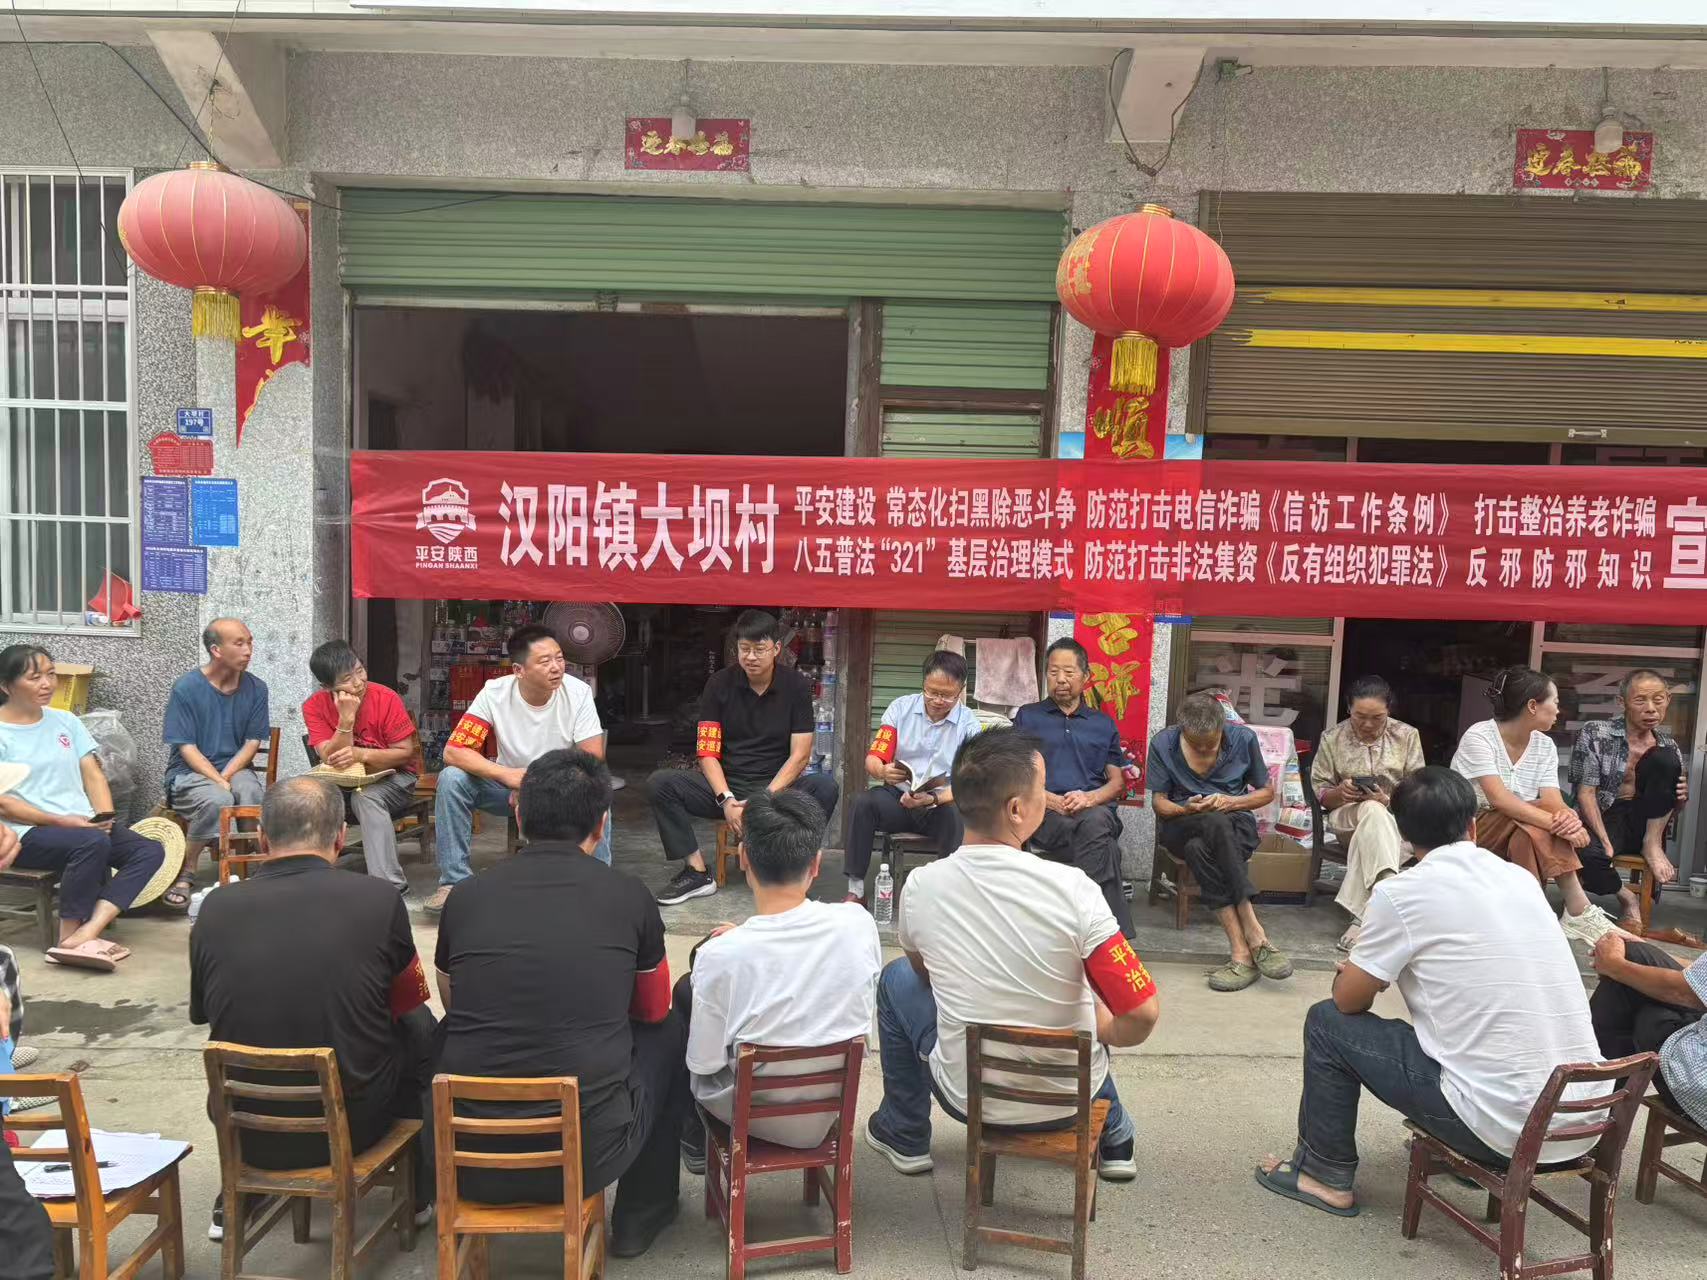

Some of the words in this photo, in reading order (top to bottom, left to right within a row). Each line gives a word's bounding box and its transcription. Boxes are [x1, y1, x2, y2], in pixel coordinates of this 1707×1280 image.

[498, 480, 779, 574] 汉阳镇大坝村
[794, 485, 876, 526] 平安建设
[887, 486, 1077, 529] 常态化扫黑除恶斗争
[1086, 488, 1261, 532] 防范打击电信诈骗
[1268, 490, 1449, 536] 《信访工作条例》
[1474, 493, 1657, 538] 打击整治养老诈骗
[415, 545, 478, 562] 平安陕西
[947, 538, 1074, 580] 基层治理模式
[1084, 539, 1258, 583] 防范打击非法集资
[1265, 541, 1448, 587] 《反有组织犯罪法》
[1466, 546, 1652, 591] 反邪防邪知识
[1663, 496, 1707, 589] 宣
